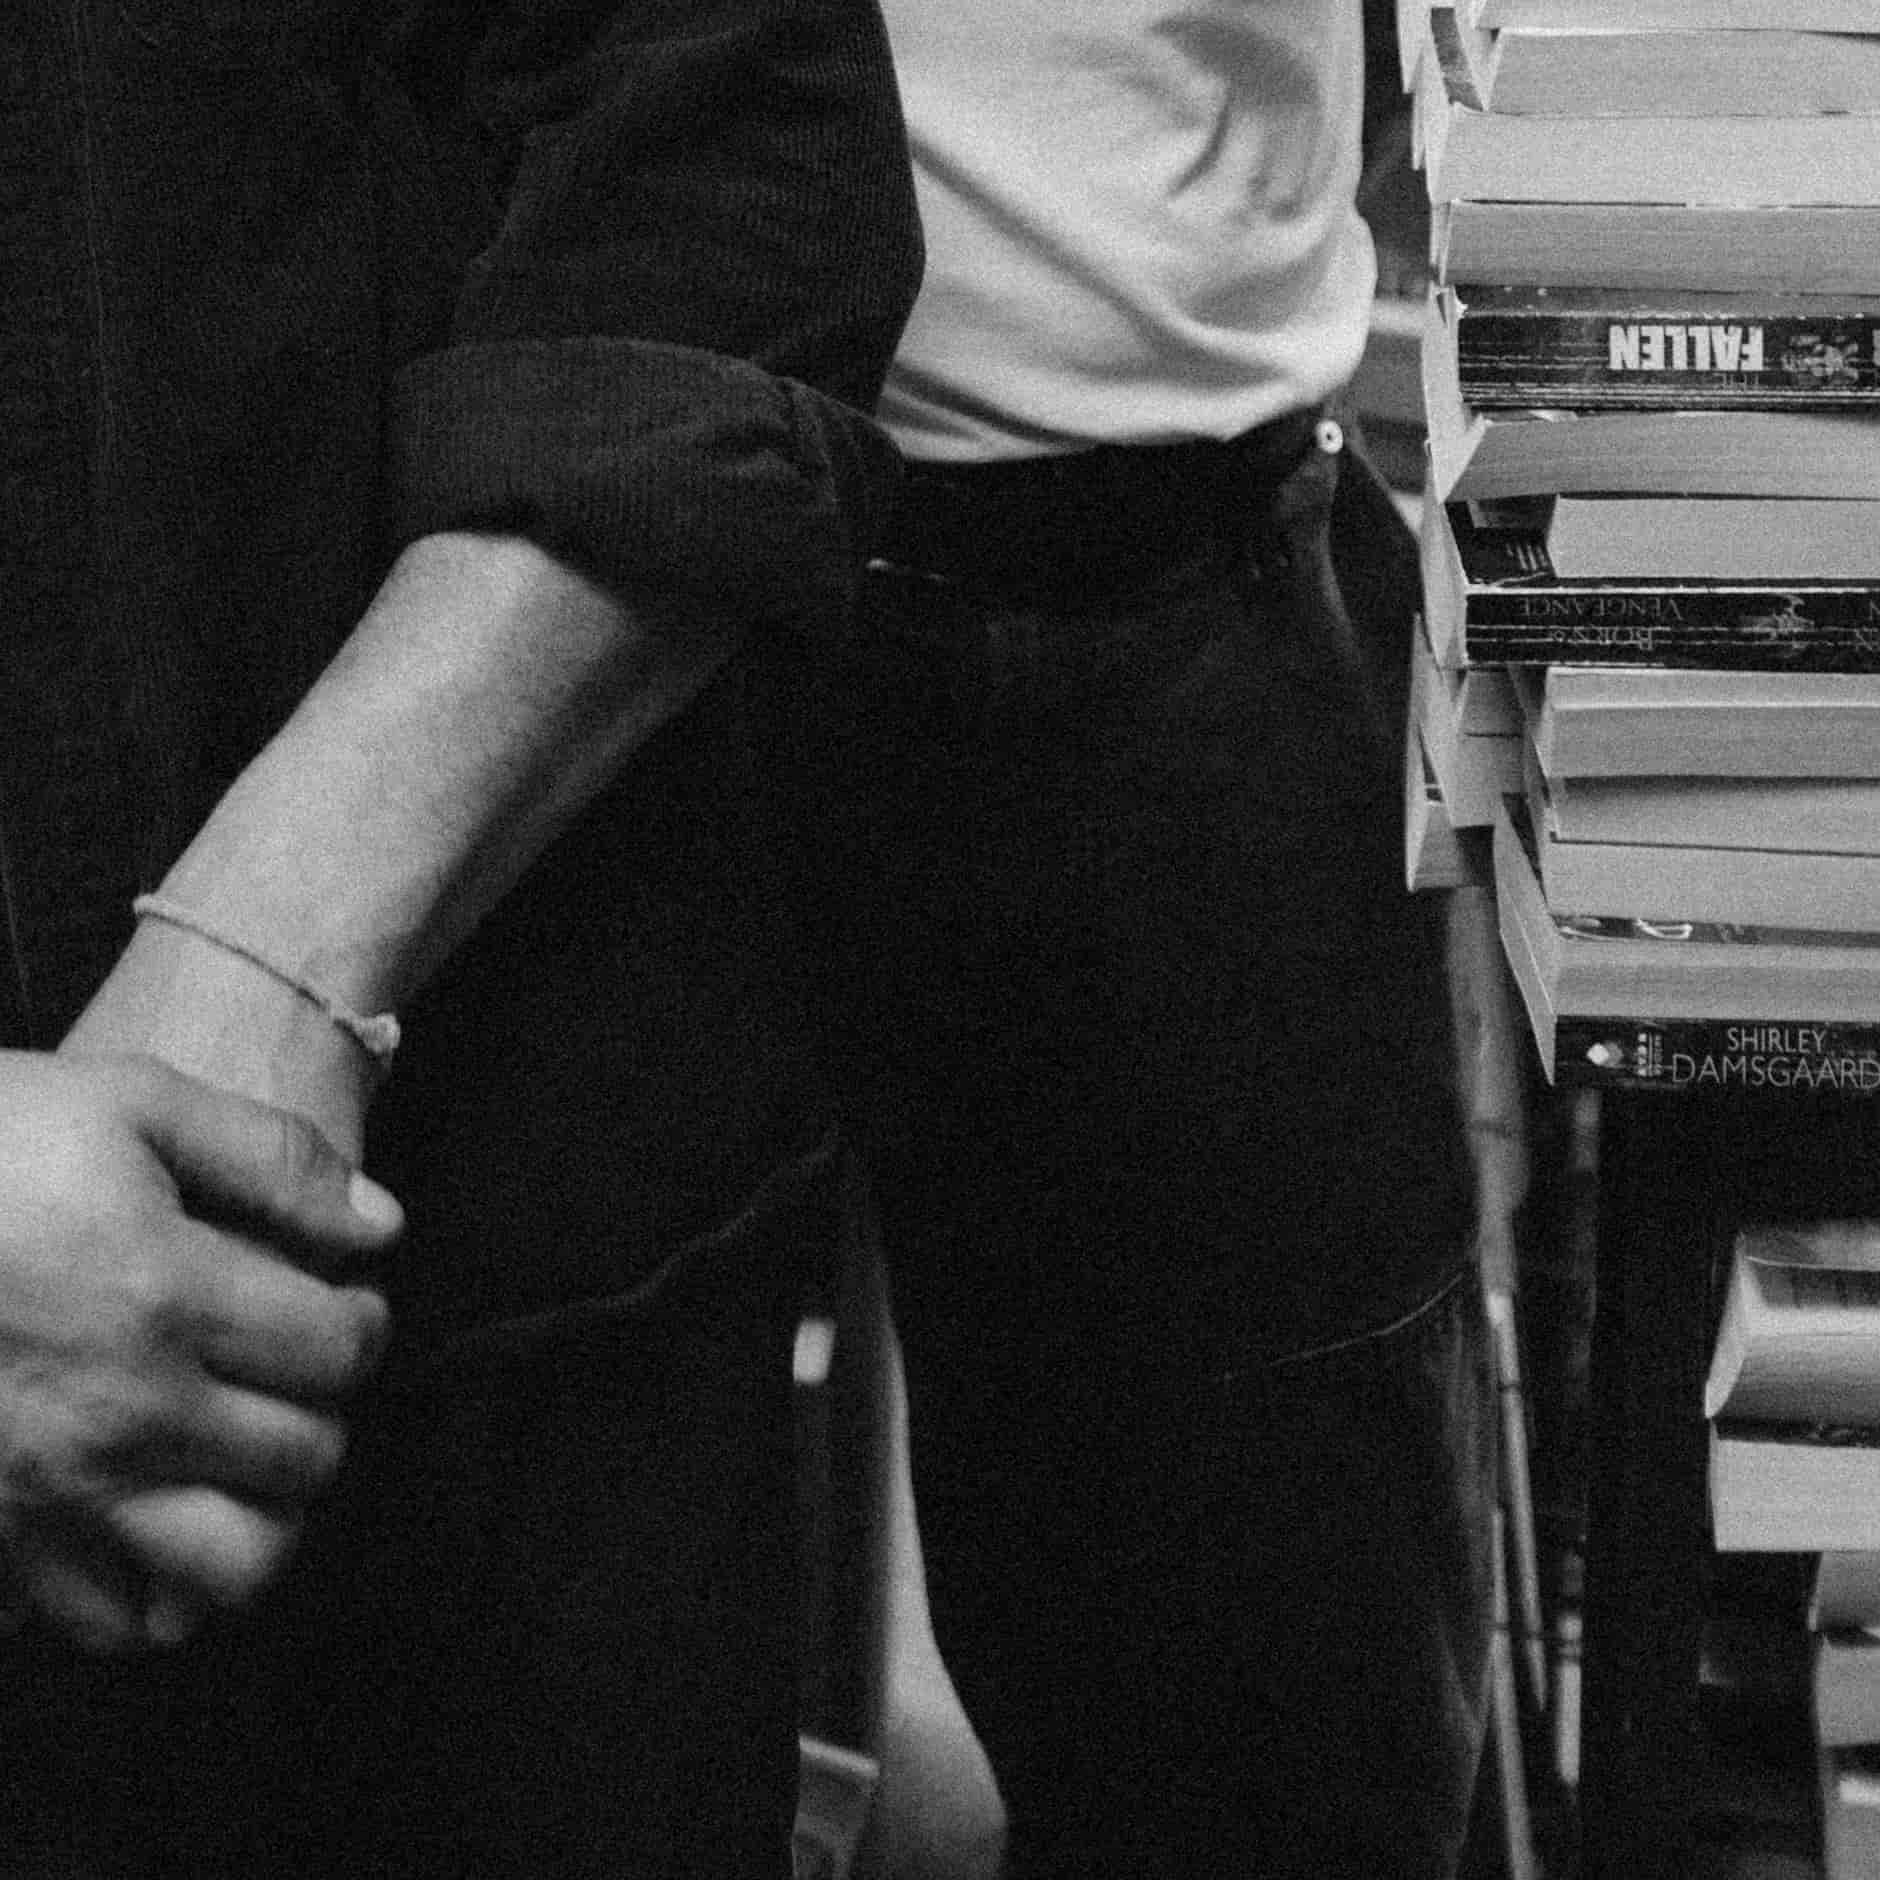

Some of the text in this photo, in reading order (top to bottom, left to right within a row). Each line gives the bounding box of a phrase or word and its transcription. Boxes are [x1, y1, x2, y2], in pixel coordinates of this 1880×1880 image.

[1608, 324, 1764, 371] FALLEN
[1513, 595, 1684, 621] VENGEANCE
[1726, 1027, 1827, 1053] SHIRLEY
[1671, 1052, 1880, 1089] DAMSGAARD
